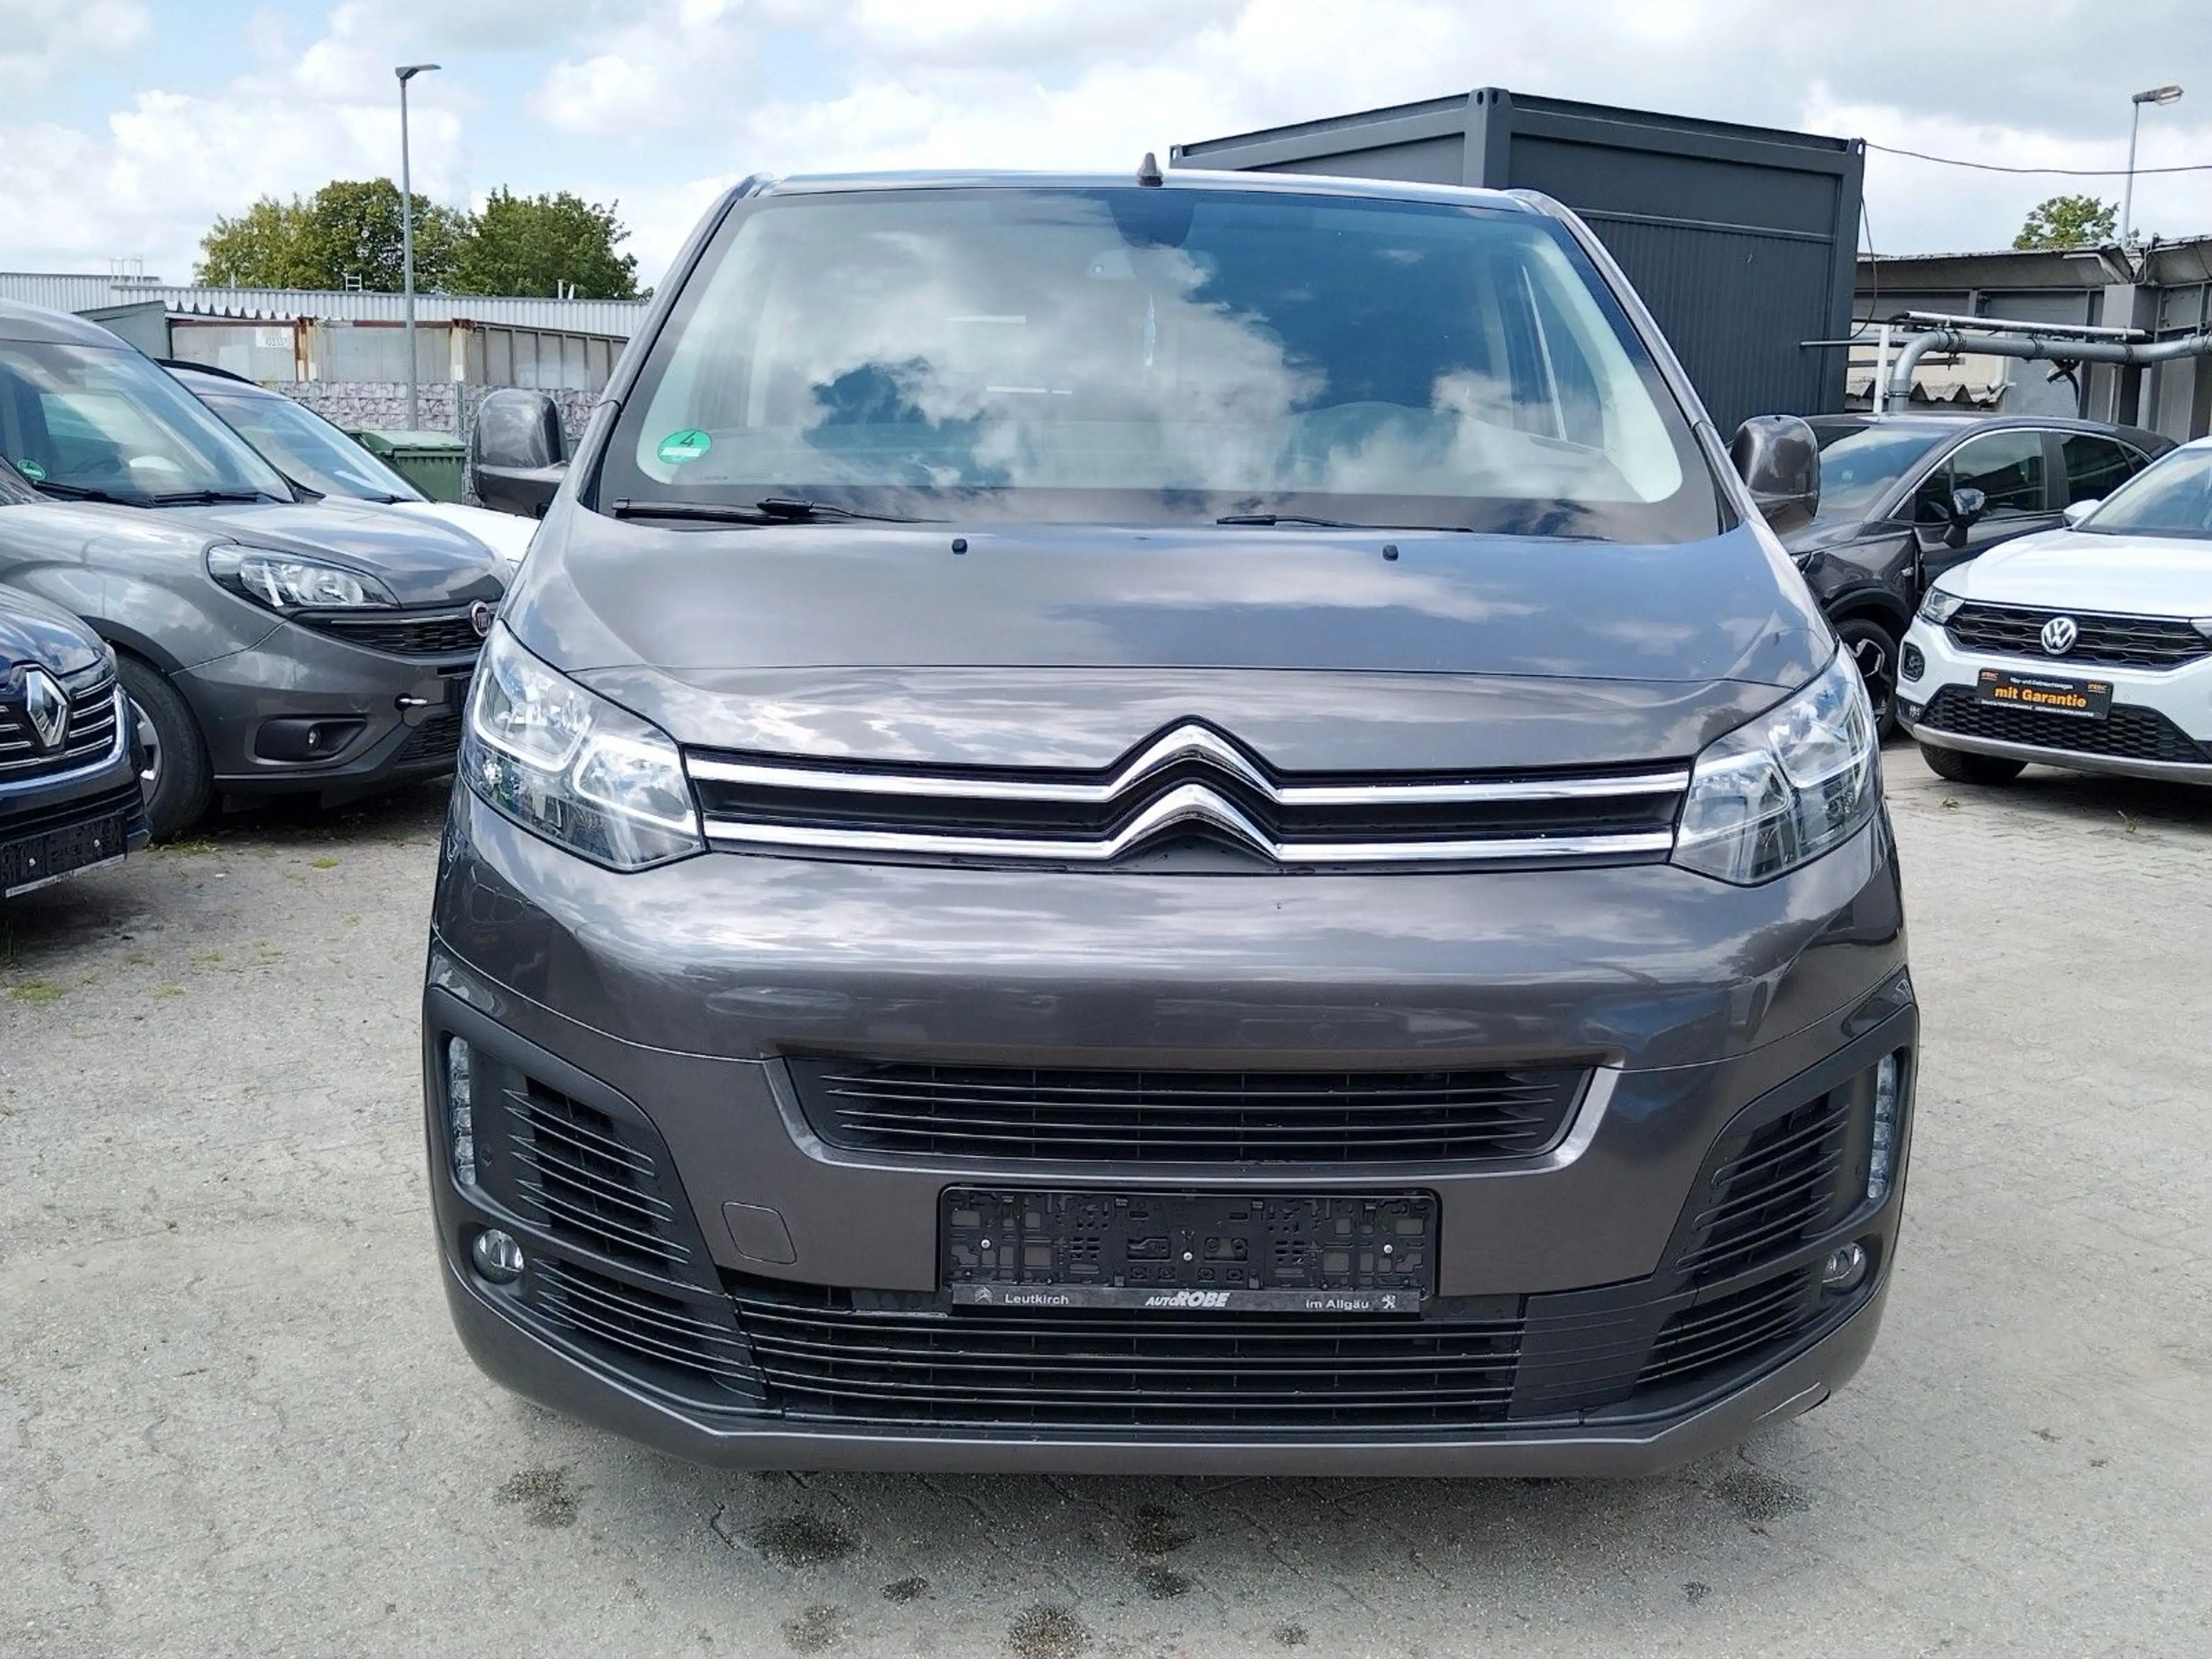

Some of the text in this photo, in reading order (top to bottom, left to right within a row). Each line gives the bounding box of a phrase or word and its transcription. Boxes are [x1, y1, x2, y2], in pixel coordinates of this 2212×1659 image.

[679, 431, 696, 447] 4
[1994, 686, 2018, 699] mit
[2022, 688, 2087, 708] Garantie
[1005, 1293, 1069, 1305] Leutkirch
[1305, 1299, 1323, 1309] im
[1325, 1299, 1370, 1310] Allgäu
